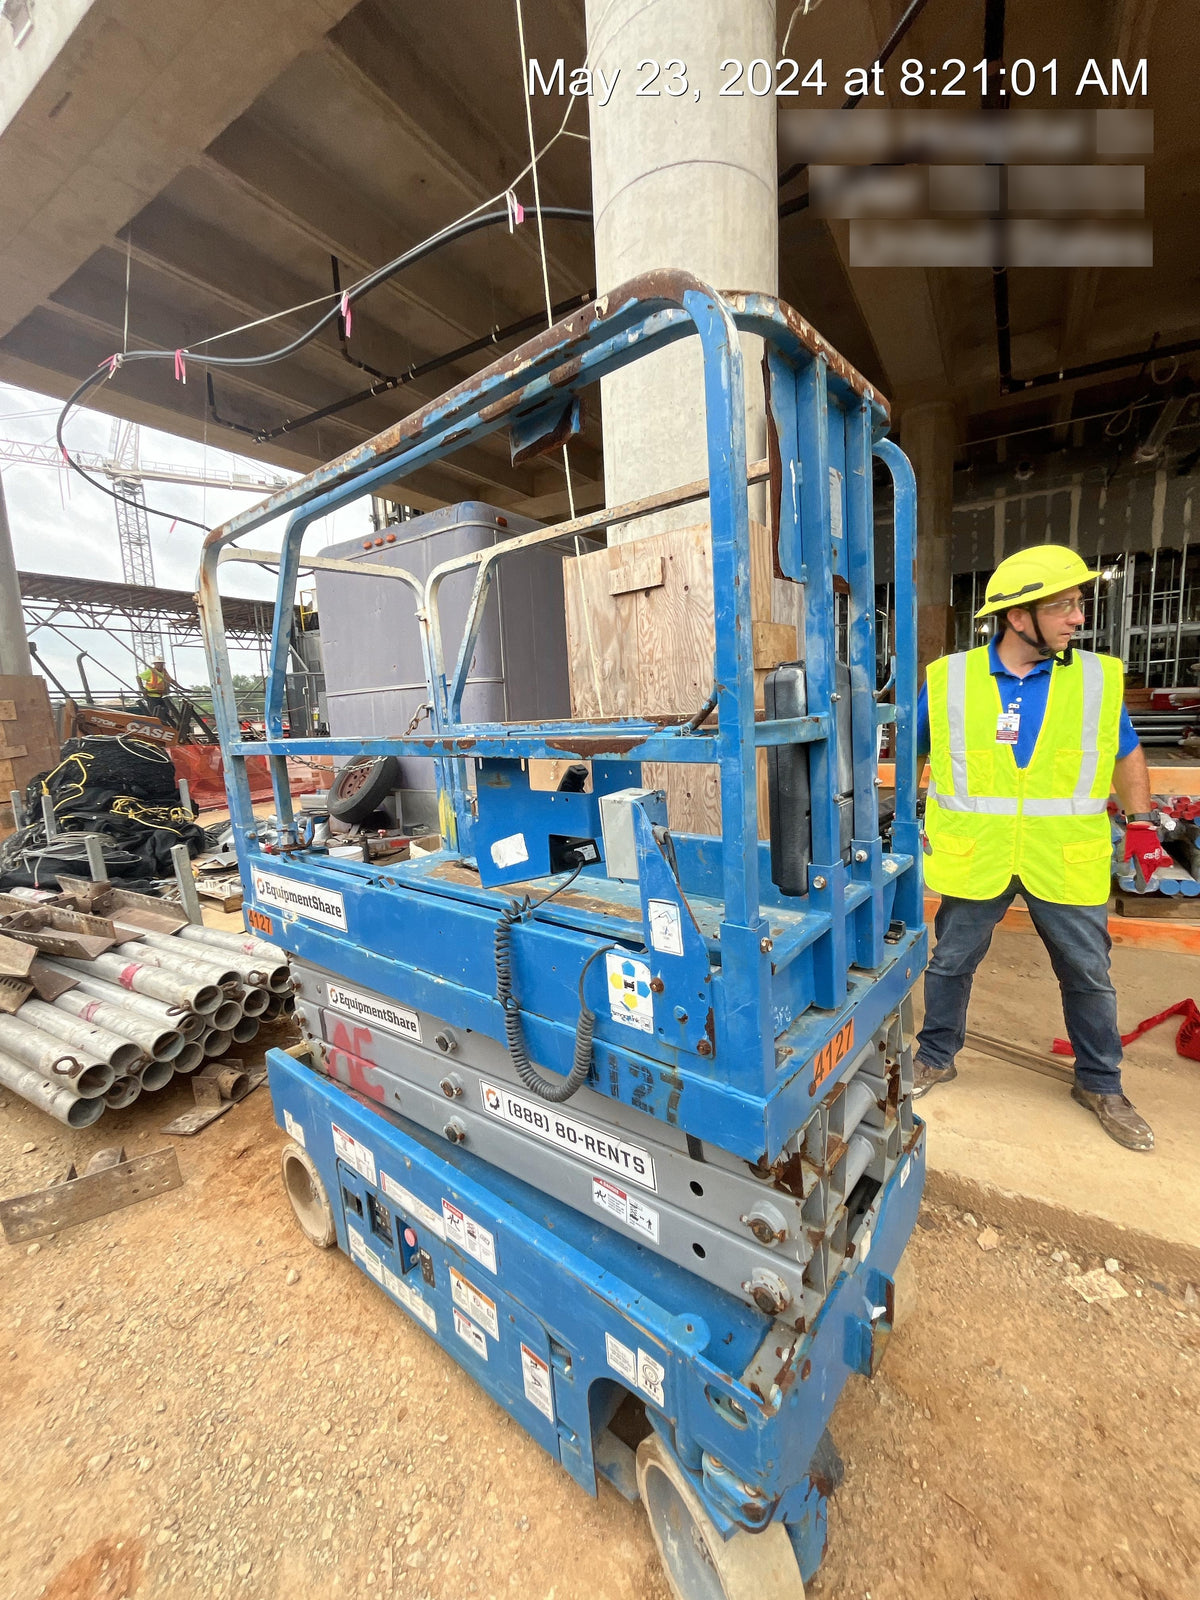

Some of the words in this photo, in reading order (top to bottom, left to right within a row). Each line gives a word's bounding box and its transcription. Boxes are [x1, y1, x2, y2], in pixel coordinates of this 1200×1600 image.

[126, 721, 176, 742] CASE
[265, 883, 342, 918] EquipmentShare
[248, 909, 271, 934] 4127
[339, 992, 418, 1032] EquipmentShare
[814, 1017, 853, 1083] 4127
[508, 1098, 550, 1132] (888)
[555, 1121, 645, 1175] 80-RENTS
